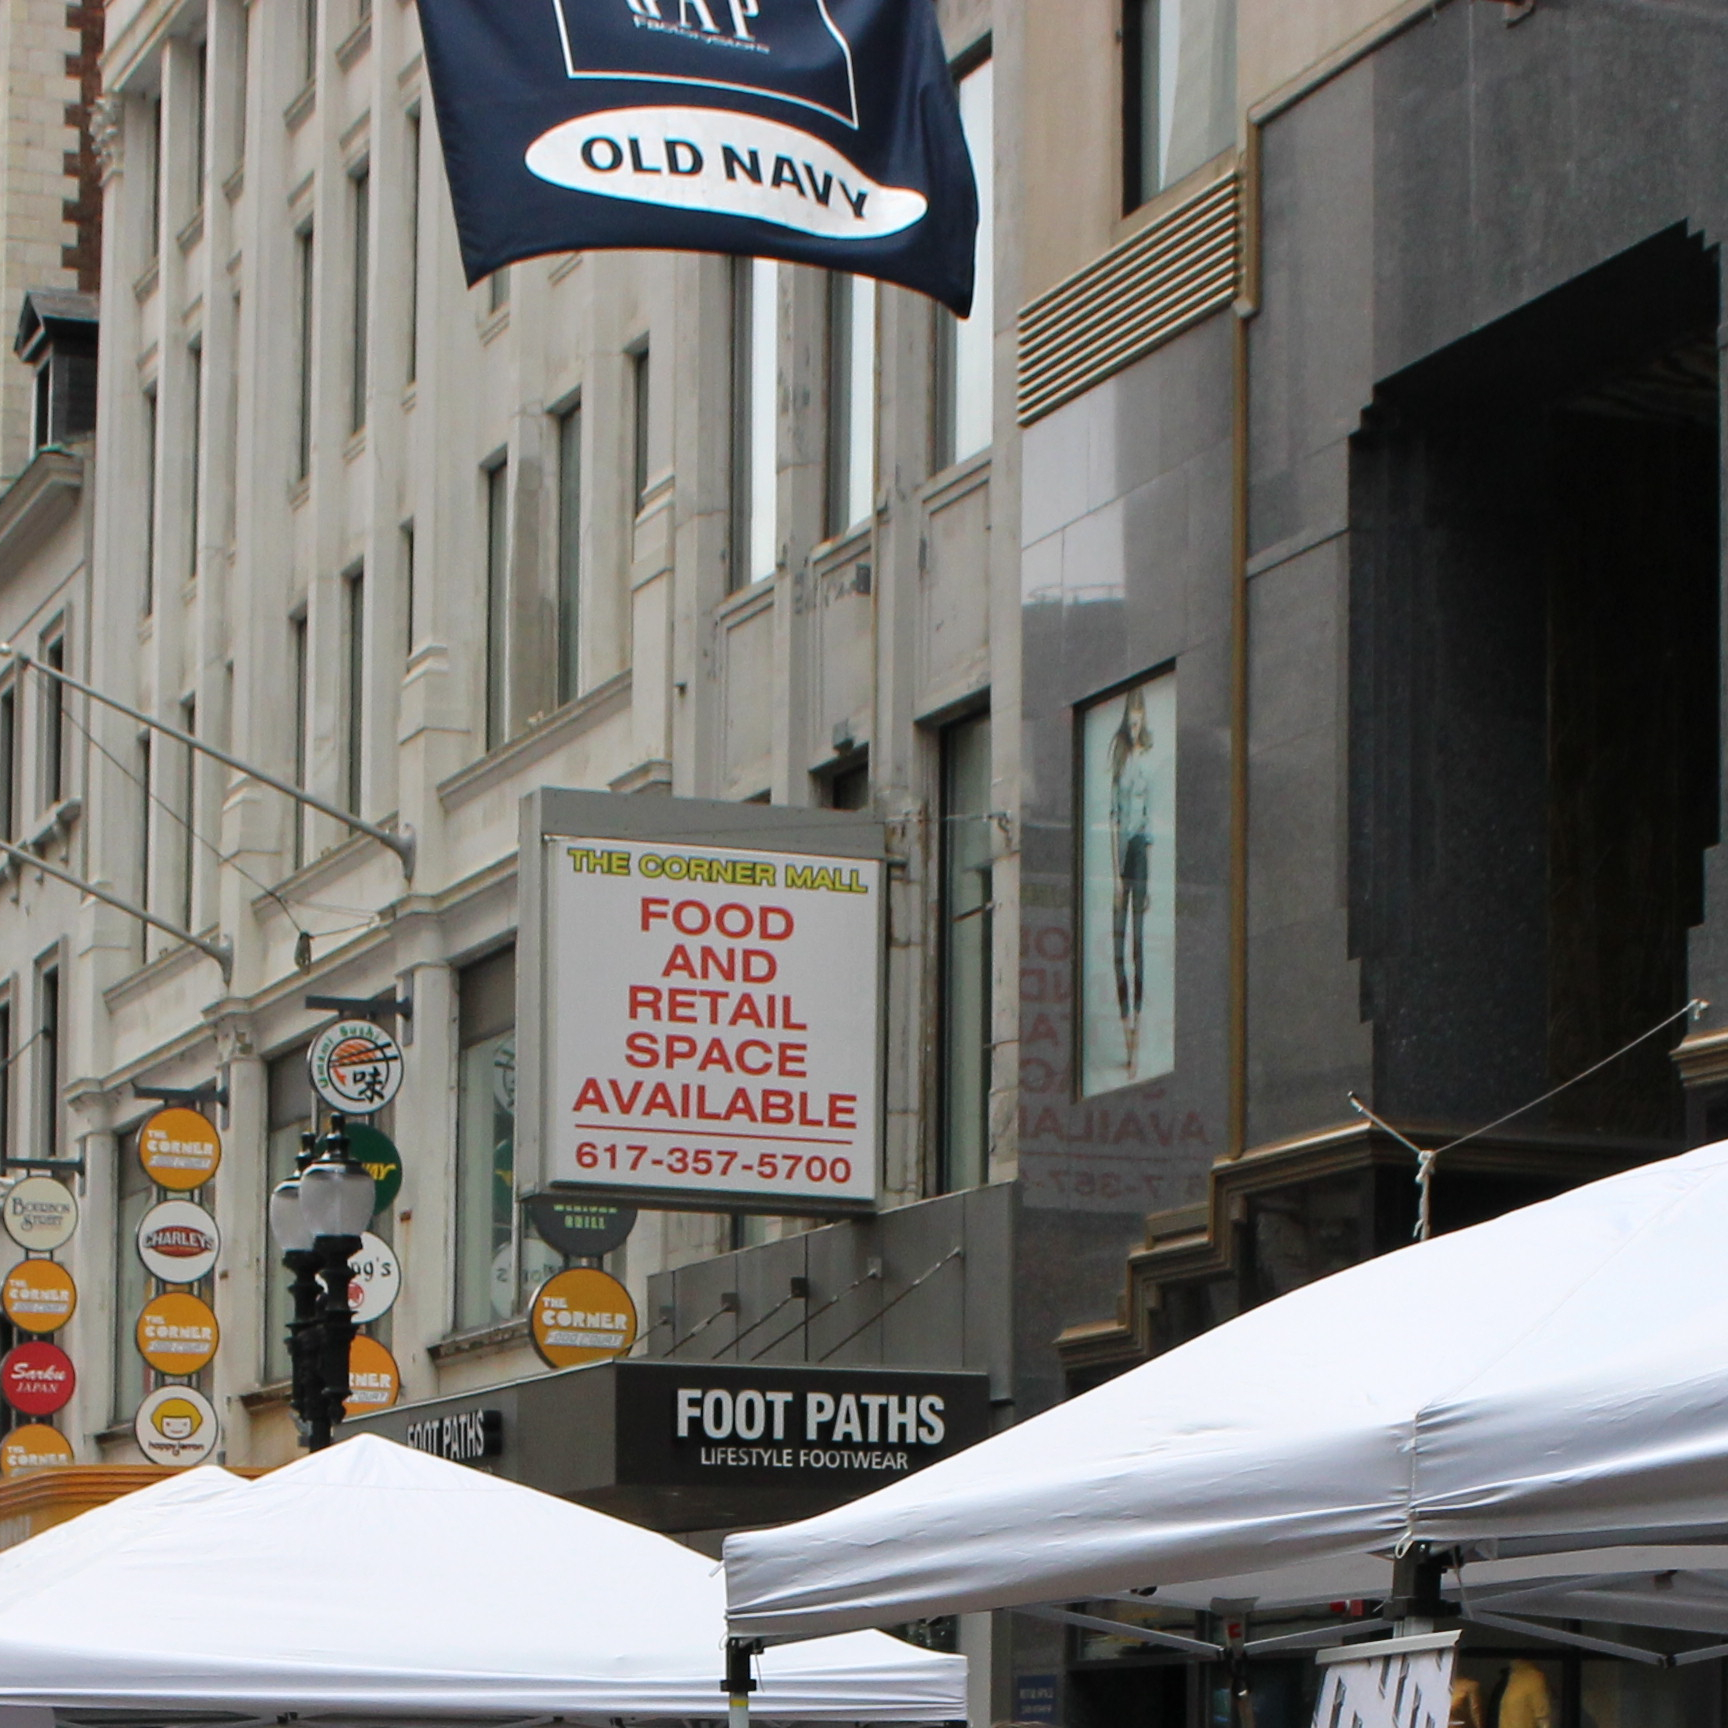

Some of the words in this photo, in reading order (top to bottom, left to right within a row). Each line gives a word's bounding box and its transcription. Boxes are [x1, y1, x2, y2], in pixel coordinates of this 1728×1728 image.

[580, 136, 704, 176] OLD
[721, 143, 870, 219] NAVY
[568, 848, 630, 876] THE
[639, 853, 776, 887] CORNER
[785, 864, 868, 894] MALL
[640, 896, 795, 941] FOOD
[661, 944, 778, 984] AND
[628, 985, 808, 1031] RETAIL
[625, 1032, 807, 1078] SPACE
[572, 1077, 858, 1129] AVAILABLE
[147, 1129, 168, 1140] THE
[146, 1139, 214, 1156] CORNER
[575, 1142, 852, 1184] 617-357-5700
[143, 1230, 215, 1250] CHARLEYS
[8, 1279, 27, 1288] THE
[8, 1288, 70, 1301] CORNER
[542, 1296, 568, 1309] THE
[145, 1315, 166, 1325] THE
[541, 1310, 628, 1330] CORNER
[145, 1325, 212, 1341] CORNER
[11, 1363, 67, 1382] Sarku
[349, 1372, 392, 1389] RNER
[16, 1381, 59, 1394] JAPAN
[676, 1388, 794, 1442] FOOT
[806, 1393, 945, 1446] PATHS
[441, 1409, 485, 1459] PATHS
[7, 1446, 25, 1455] THE
[7, 1453, 69, 1466] CORNER
[700, 1446, 793, 1468] LIFESTYLE
[799, 1450, 909, 1471] FOOTWEAR
